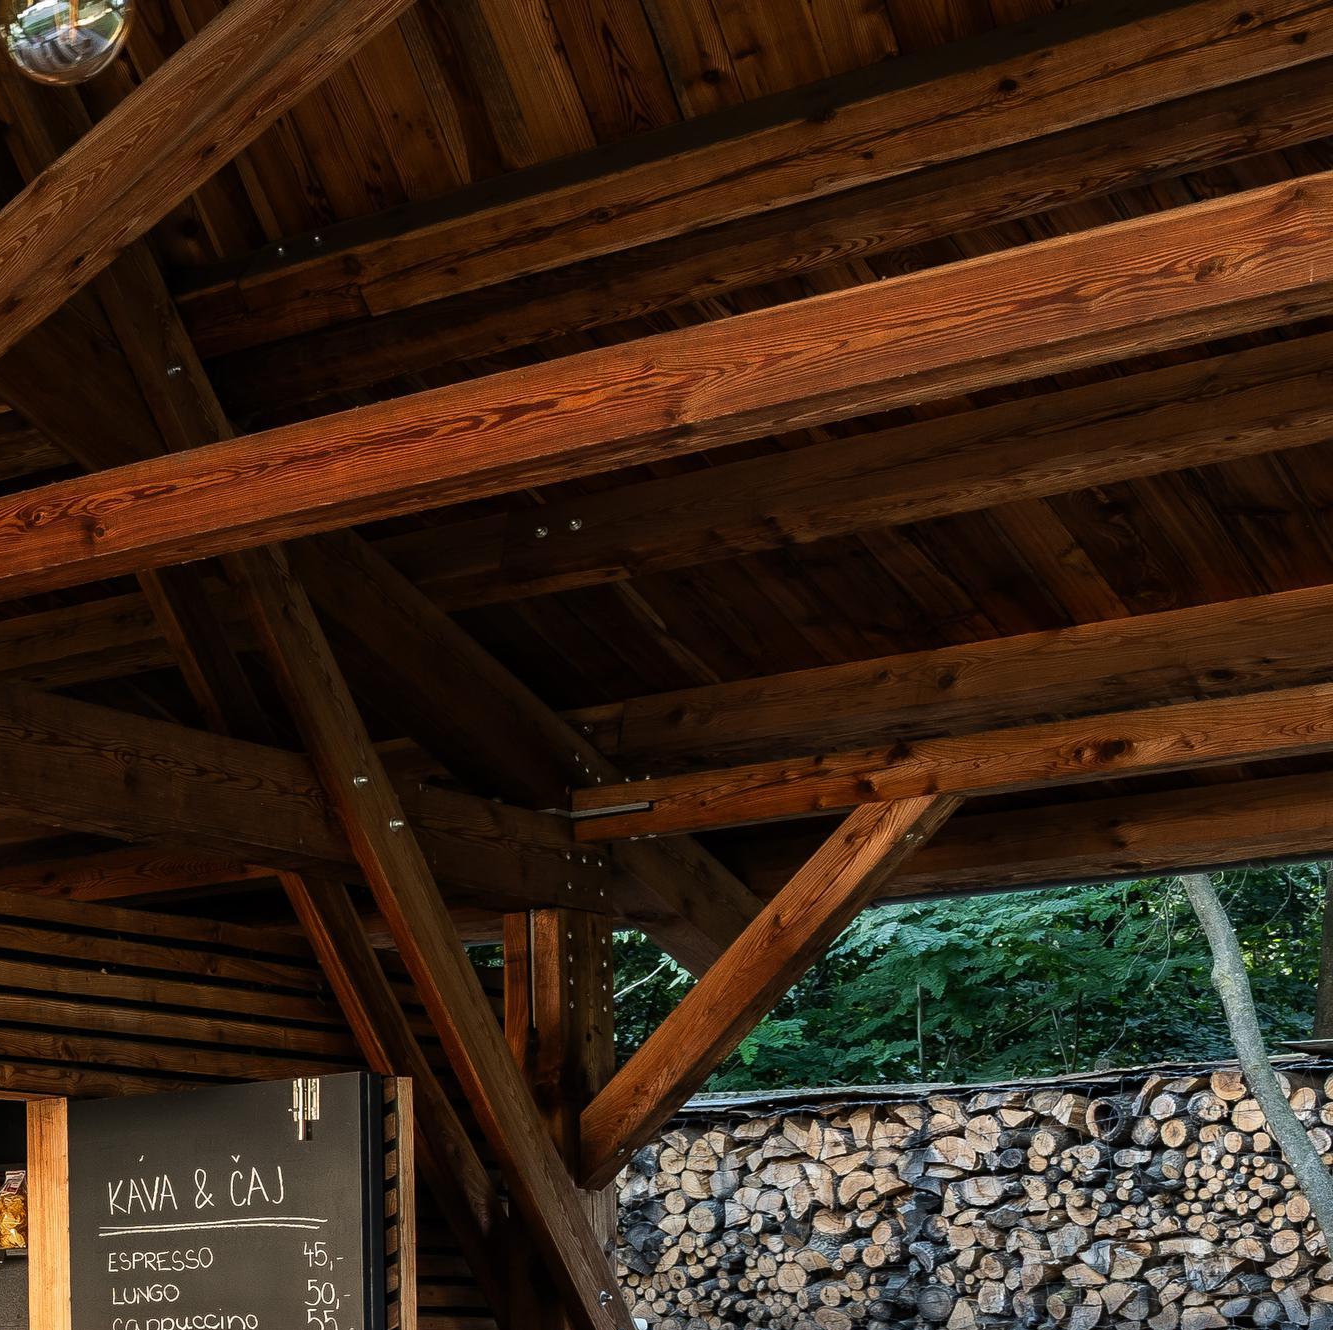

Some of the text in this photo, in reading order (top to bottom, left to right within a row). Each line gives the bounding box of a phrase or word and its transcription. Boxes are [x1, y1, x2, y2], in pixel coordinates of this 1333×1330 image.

[107, 1155, 285, 1216] KÁVA & ČAJ
[107, 1247, 214, 1273] ESPRESSO
[112, 1283, 180, 1305] LUNGO
